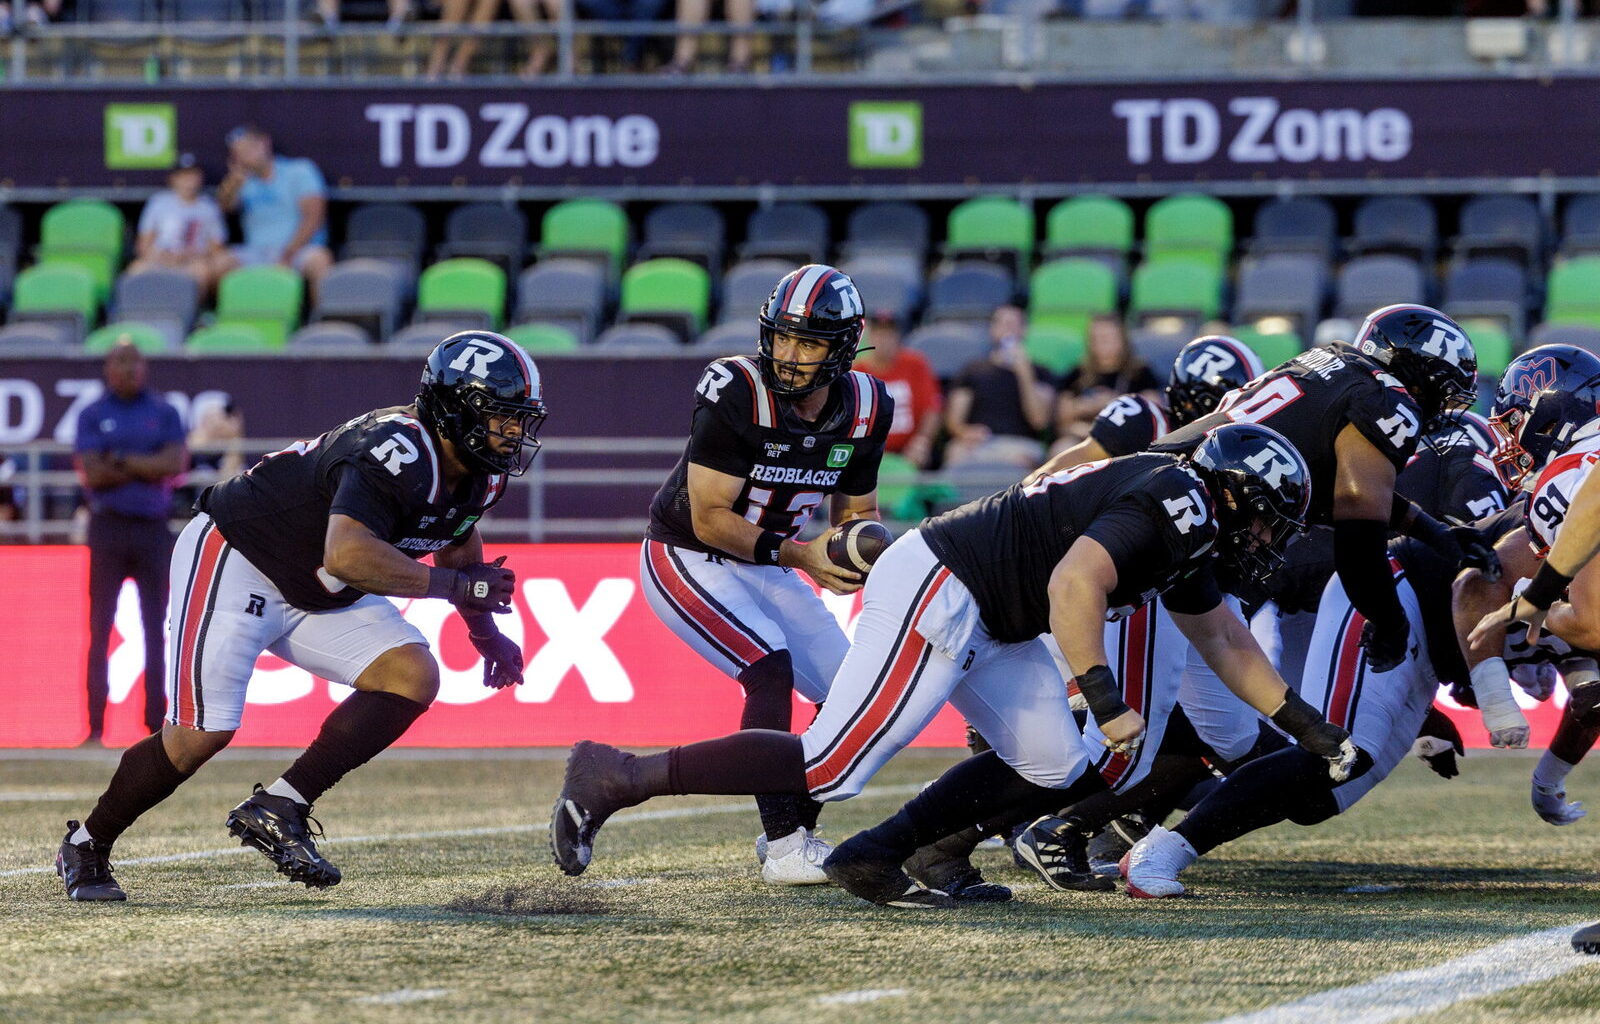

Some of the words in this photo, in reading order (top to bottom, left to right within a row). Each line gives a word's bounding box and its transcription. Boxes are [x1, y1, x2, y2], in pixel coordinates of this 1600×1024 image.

[112, 114, 169, 157] TD
[364, 103, 471, 168] TD
[479, 102, 660, 168] Zone
[856, 111, 916, 156] TD
[1112, 98, 1222, 164] TD
[1228, 97, 1413, 163] Zone
[449, 339, 503, 379] R
[1421, 319, 1465, 367] R
[696, 363, 734, 403] R
[1186, 345, 1236, 386] R
[1100, 396, 1142, 427] R
[1376, 403, 1419, 449] R
[370, 432, 419, 477] R
[749, 463, 842, 486] REDBLACKS
[767, 450, 781, 458] BET
[833, 448, 849, 462] TD
[1243, 440, 1298, 490] R
[1162, 489, 1207, 534] R
[1534, 482, 1570, 530] 91
[245, 593, 265, 617] R
